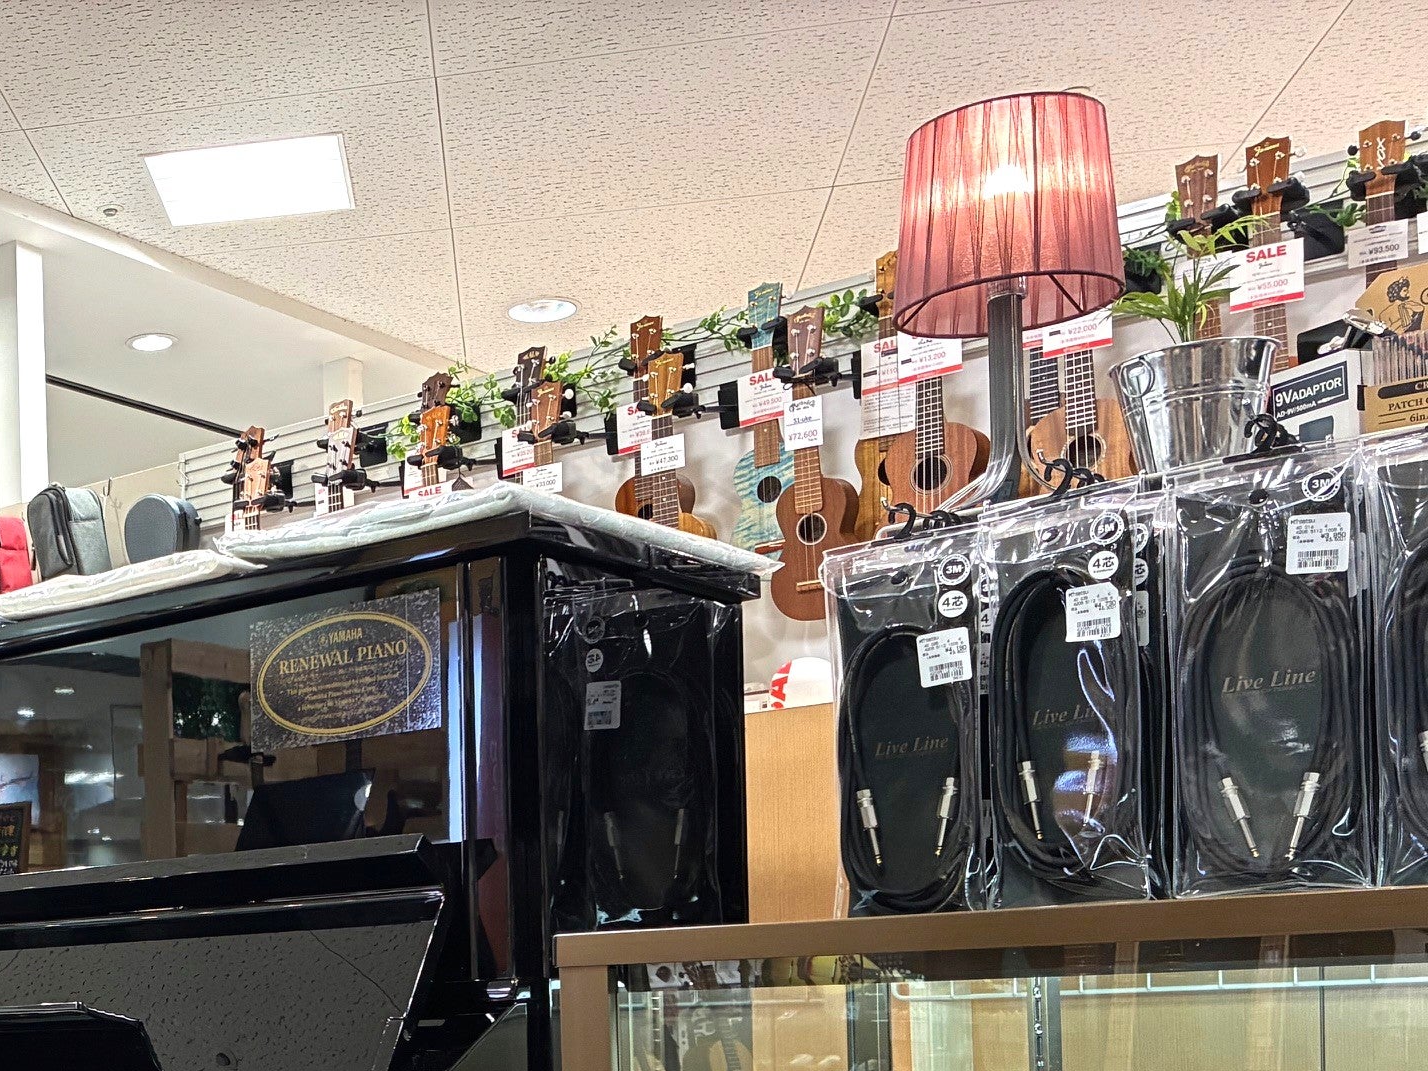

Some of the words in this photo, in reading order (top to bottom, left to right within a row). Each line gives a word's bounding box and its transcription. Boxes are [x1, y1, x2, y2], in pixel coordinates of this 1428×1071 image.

[1246, 245, 1287, 263] SALE
[873, 339, 898, 353] SAL
[749, 373, 776, 386] SAL
[1388, 398, 1423, 412] PATCH
[1311, 479, 1331, 489] 3M
[945, 564, 963, 574] 3M
[327, 627, 363, 645] YAMAHA
[278, 649, 353, 675] RENEWAL
[356, 640, 408, 662] PIANO
[1222, 675, 1264, 694] Live
[1271, 669, 1317, 688] Line
[1033, 709, 1068, 726] Live
[875, 741, 911, 757] Live
[913, 736, 949, 752] Line
